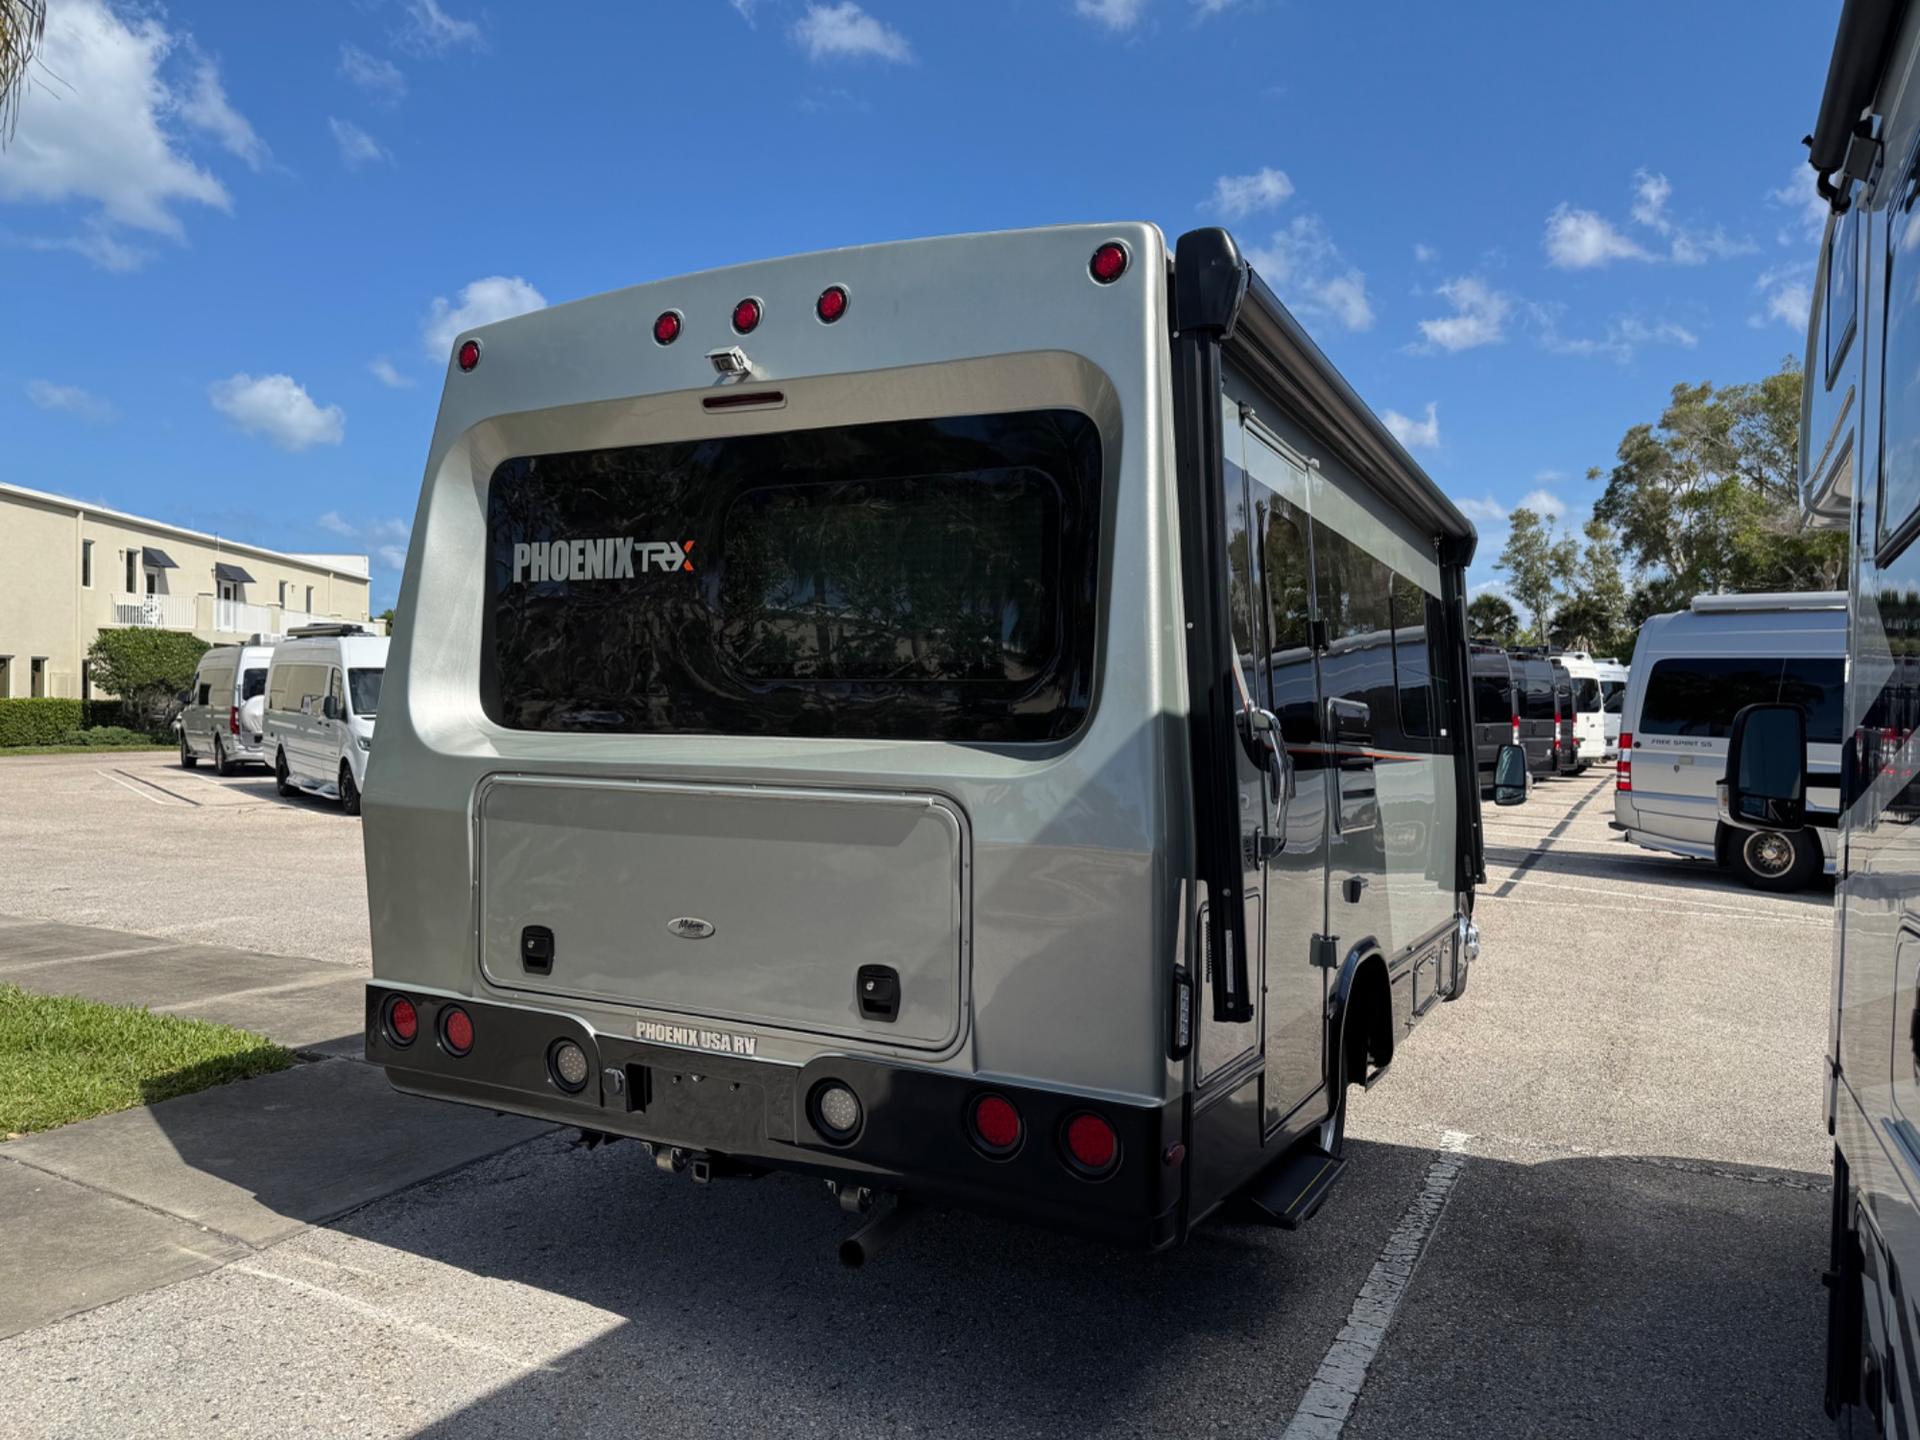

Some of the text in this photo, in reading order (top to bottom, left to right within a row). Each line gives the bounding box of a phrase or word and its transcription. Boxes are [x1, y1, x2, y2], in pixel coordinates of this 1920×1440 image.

[513, 537, 635, 583] PHOENIX
[636, 1021, 756, 1054] PHOENIX USA RV
